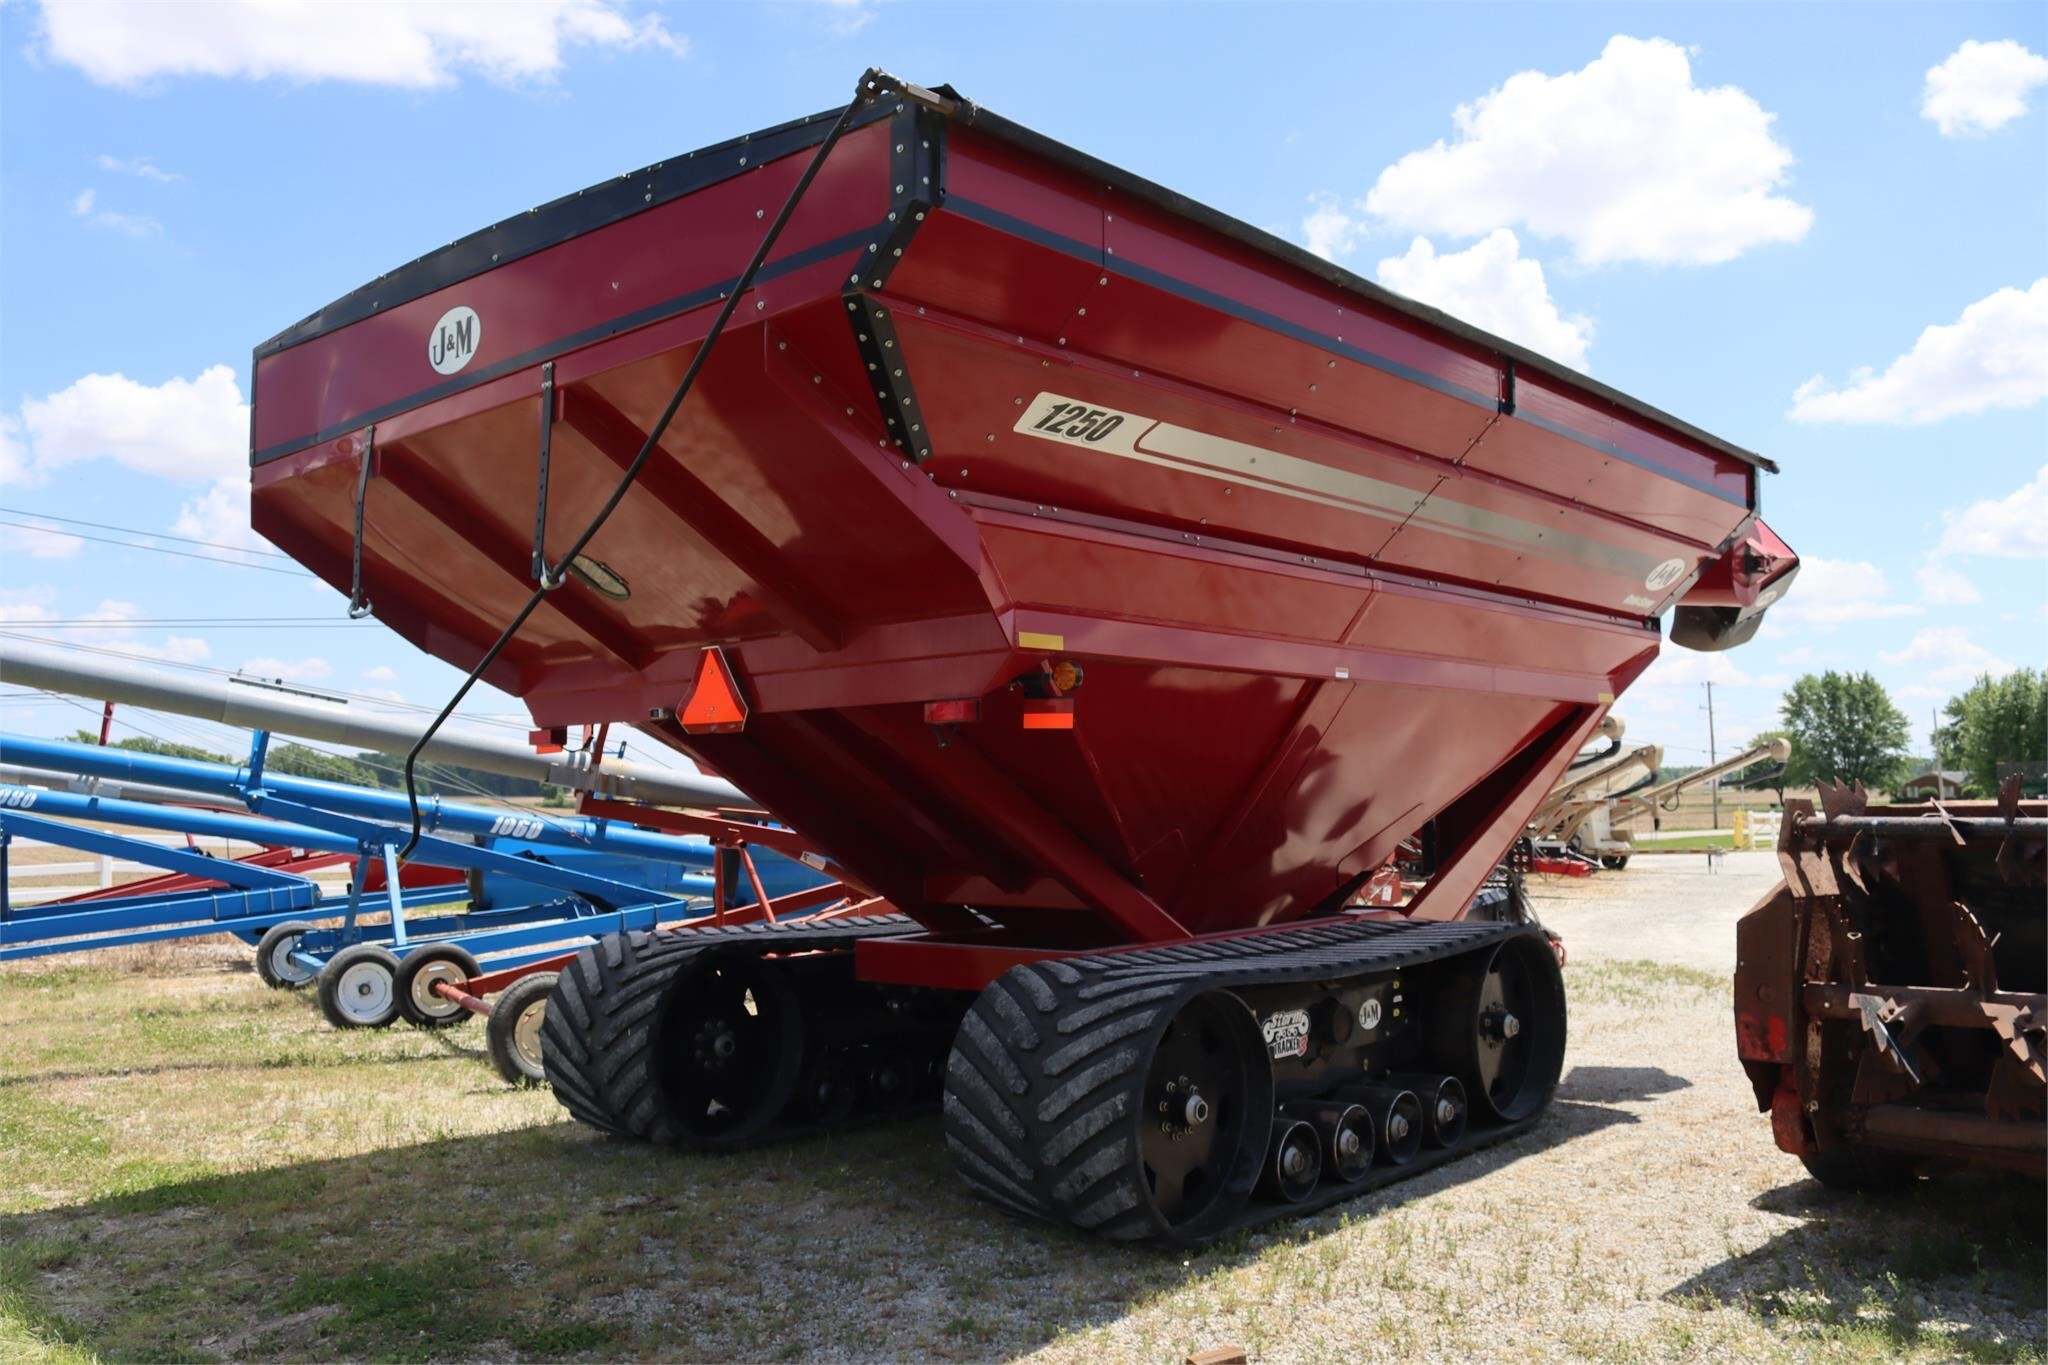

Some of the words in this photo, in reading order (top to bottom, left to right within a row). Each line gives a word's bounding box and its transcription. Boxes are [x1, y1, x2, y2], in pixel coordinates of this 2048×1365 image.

[432, 315, 473, 366] J&M
[1033, 402, 1125, 442] 1250
[489, 816, 544, 839] 1060
[1270, 1011, 1303, 1028] Storm
